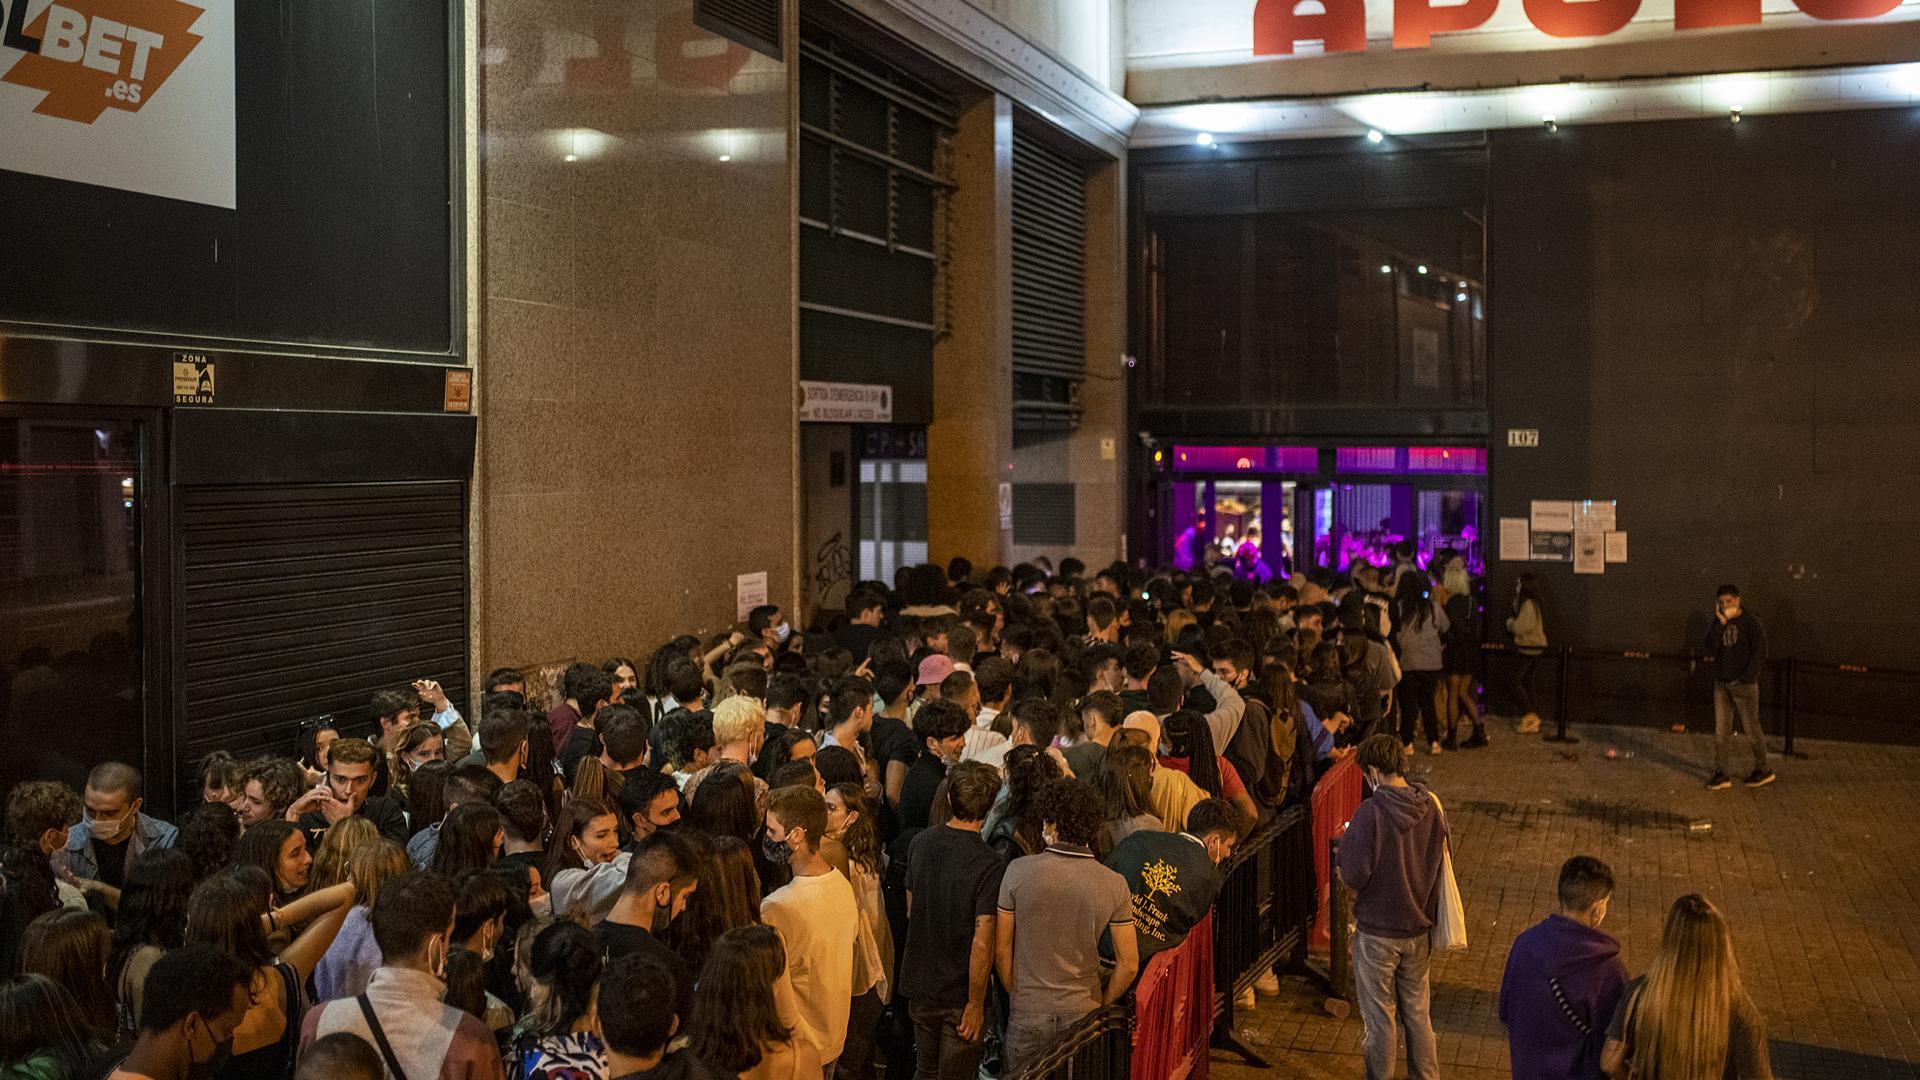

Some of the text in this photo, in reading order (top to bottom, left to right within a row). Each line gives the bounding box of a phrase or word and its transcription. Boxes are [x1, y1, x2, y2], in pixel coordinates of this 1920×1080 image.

[0, 0, 164, 81] LBET
[104, 79, 142, 104] .es
[182, 354, 207, 363] ZONA
[176, 395, 213, 404] SEGURA
[1511, 431, 1537, 446] 107
[1131, 905, 1160, 928] ndscape
[1148, 903, 1168, 923] Frank
[1151, 927, 1166, 941] Inc.
